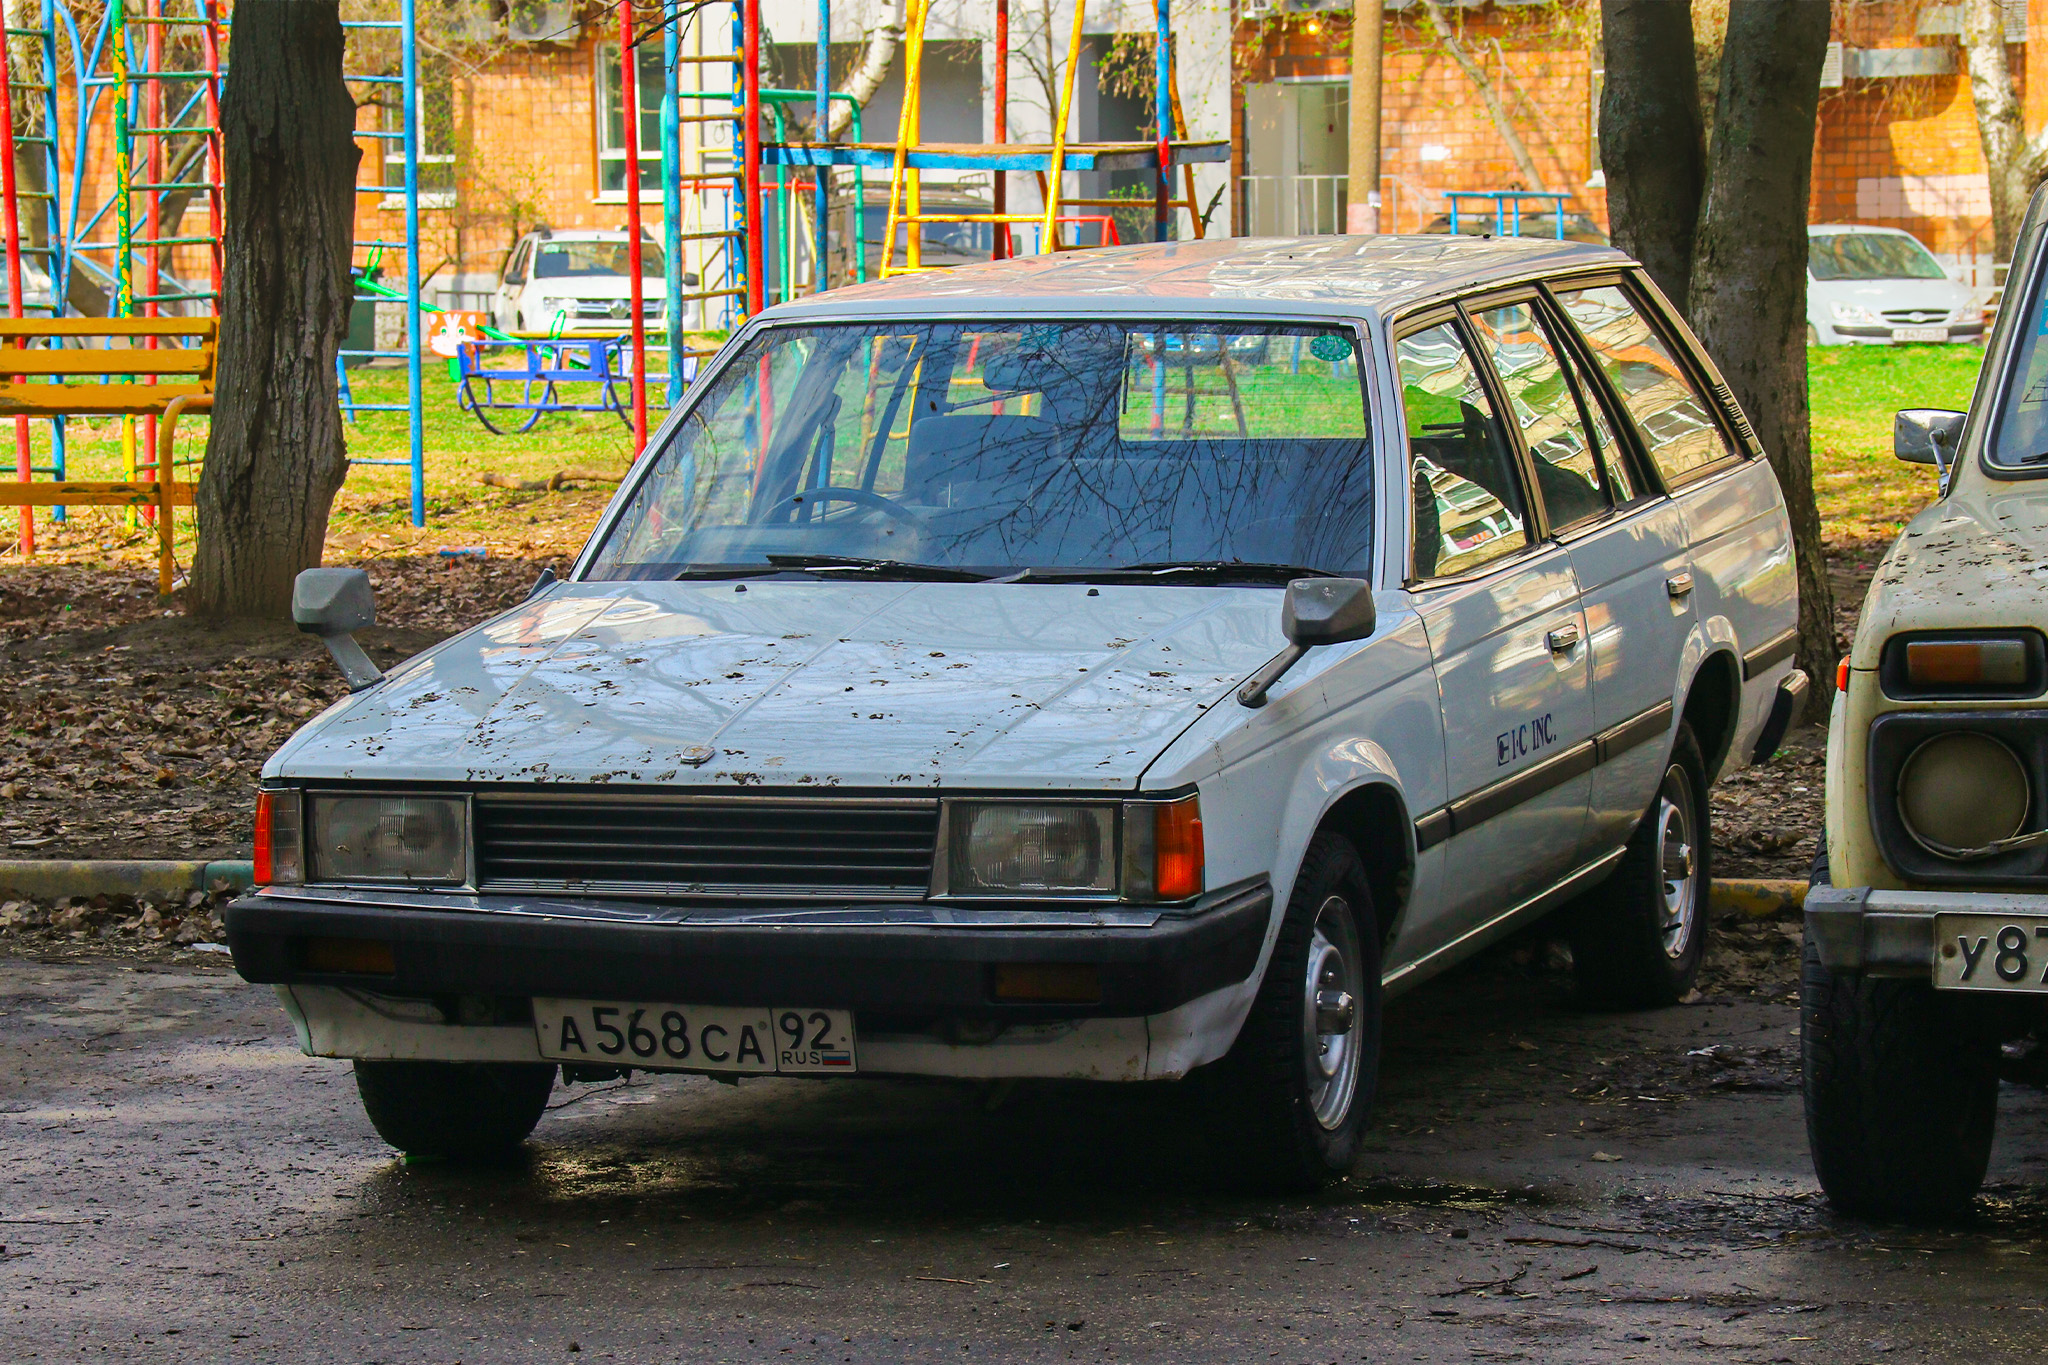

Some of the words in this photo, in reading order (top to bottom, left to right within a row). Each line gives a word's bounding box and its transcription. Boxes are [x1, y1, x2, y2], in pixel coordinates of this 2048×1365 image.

[1532, 713, 1556, 751] INC.
[560, 1006, 765, 1064] А568СА
[780, 1011, 834, 1049] 92
[781, 1051, 820, 1065] RUS
